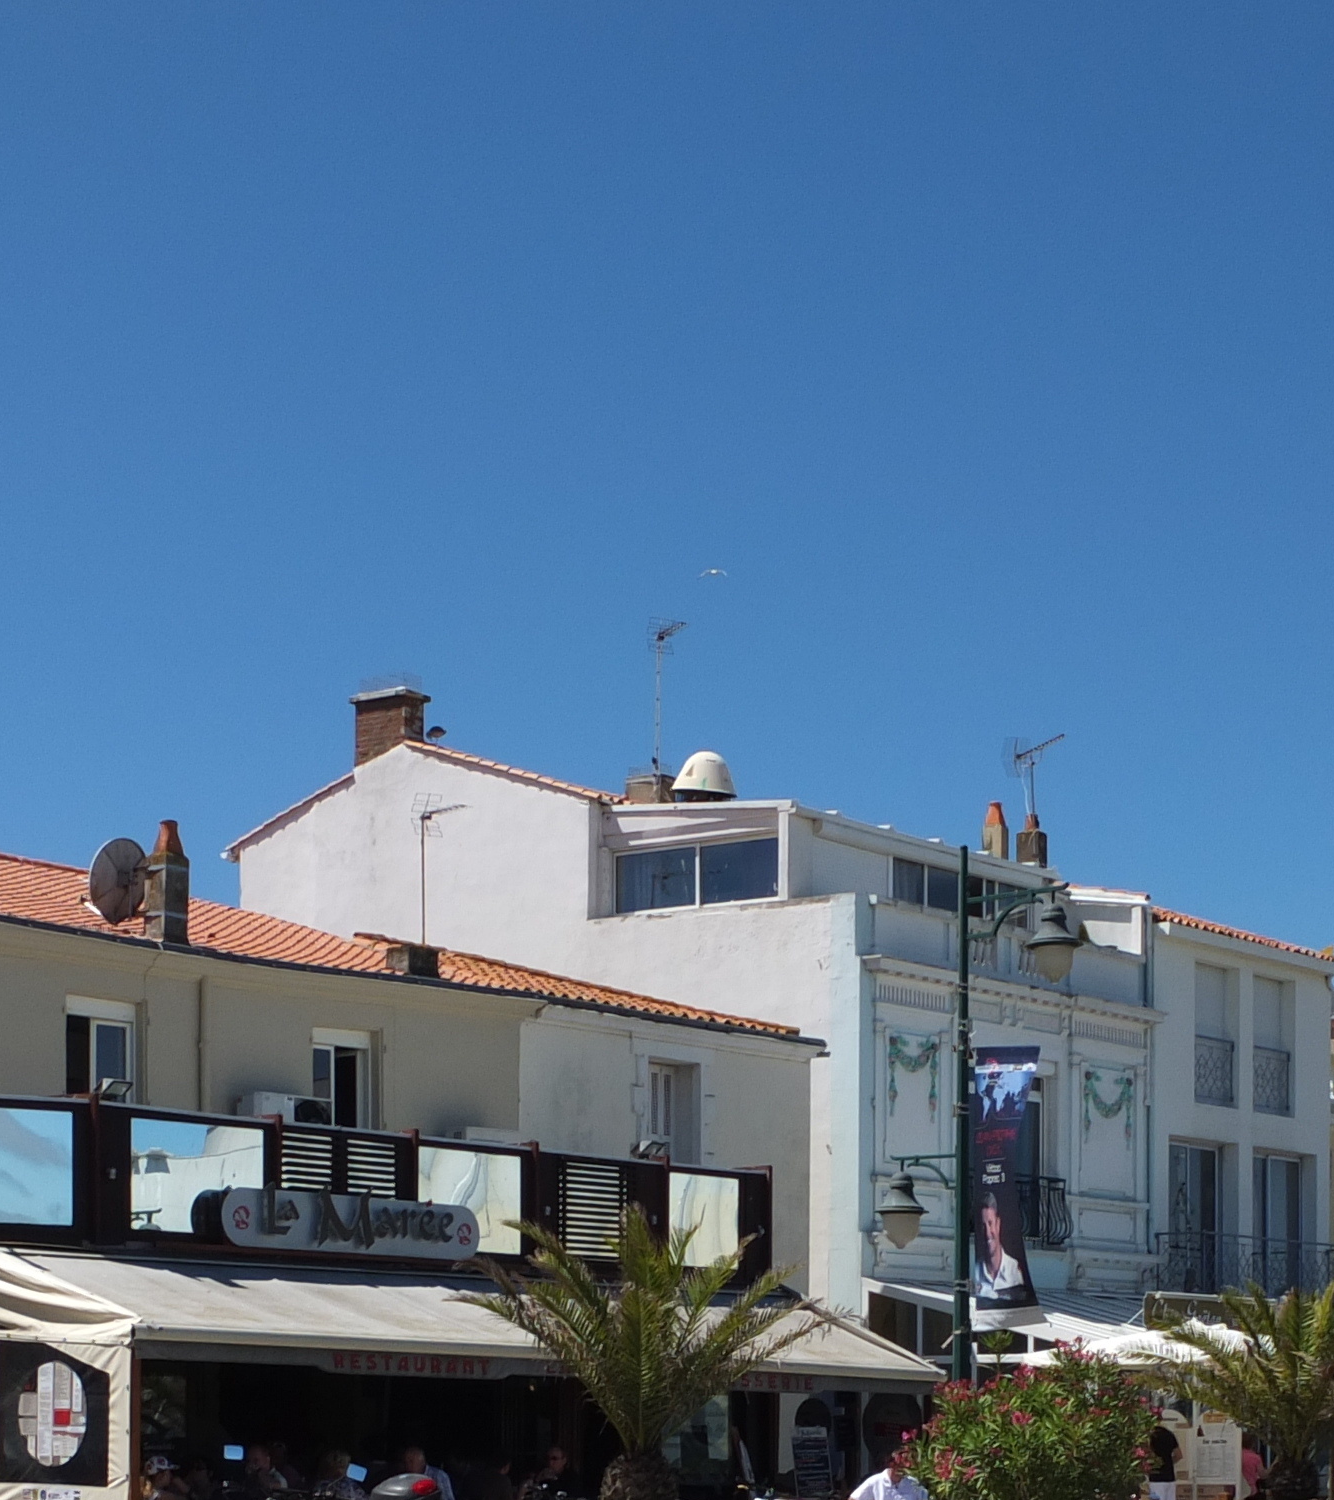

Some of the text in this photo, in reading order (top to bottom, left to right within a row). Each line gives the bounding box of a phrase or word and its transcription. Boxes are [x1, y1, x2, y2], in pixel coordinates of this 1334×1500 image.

[262, 1182, 454, 1250] La Marée
[333, 1352, 490, 1376] RESTAURANT
